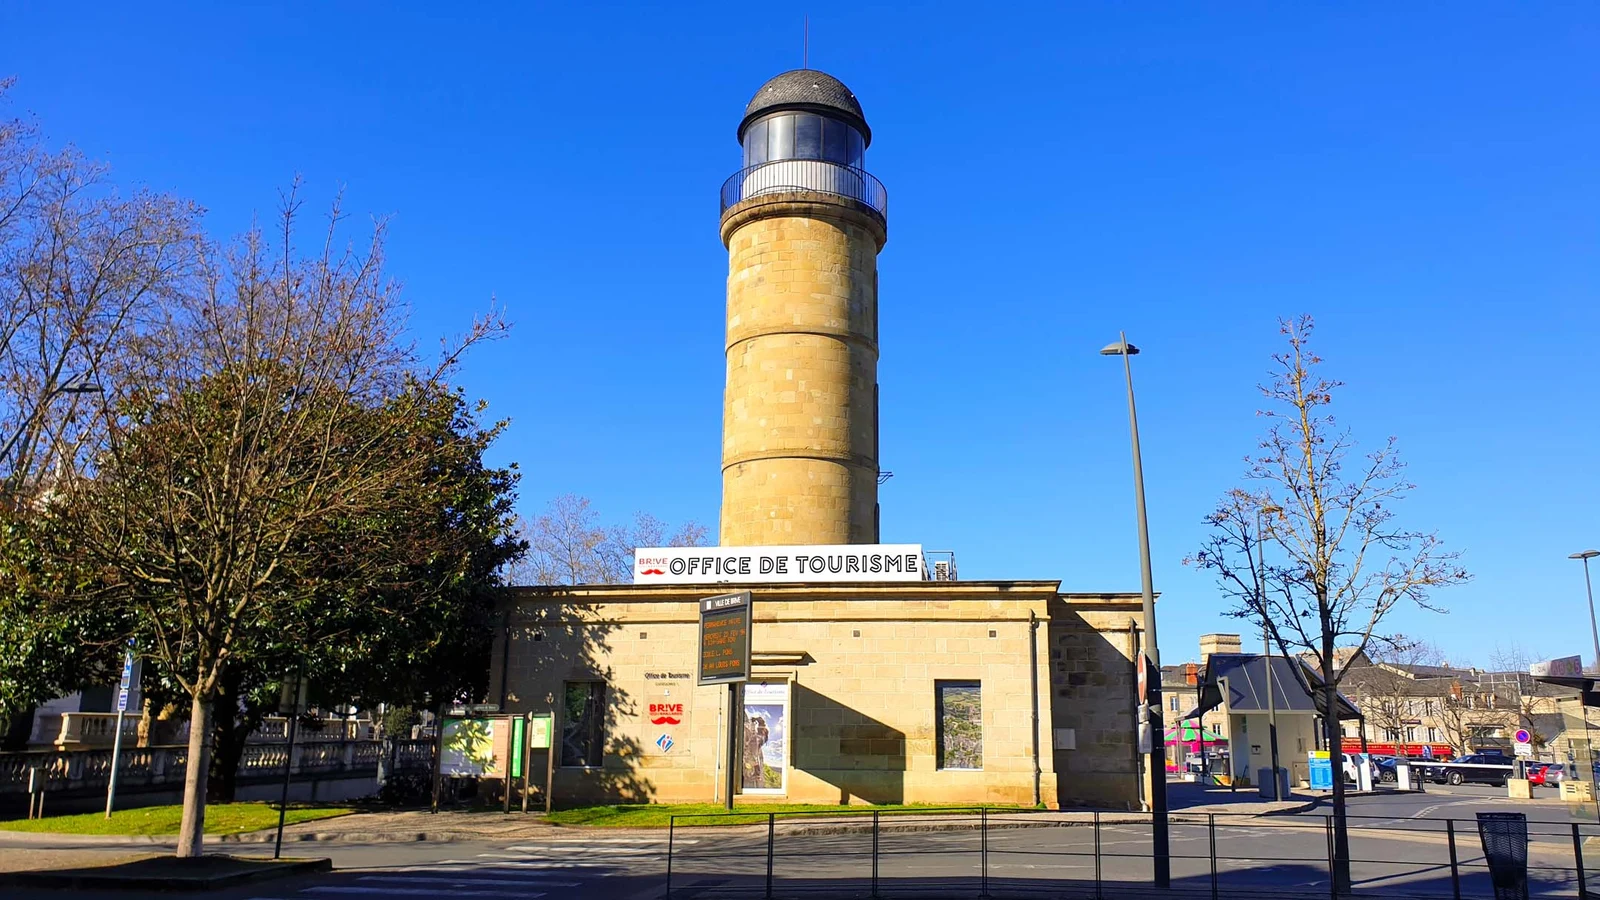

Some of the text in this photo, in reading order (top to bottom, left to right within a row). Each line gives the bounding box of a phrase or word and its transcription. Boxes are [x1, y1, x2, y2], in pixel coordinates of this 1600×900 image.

[670, 554, 917, 575] OFFICE DE TOURISME
